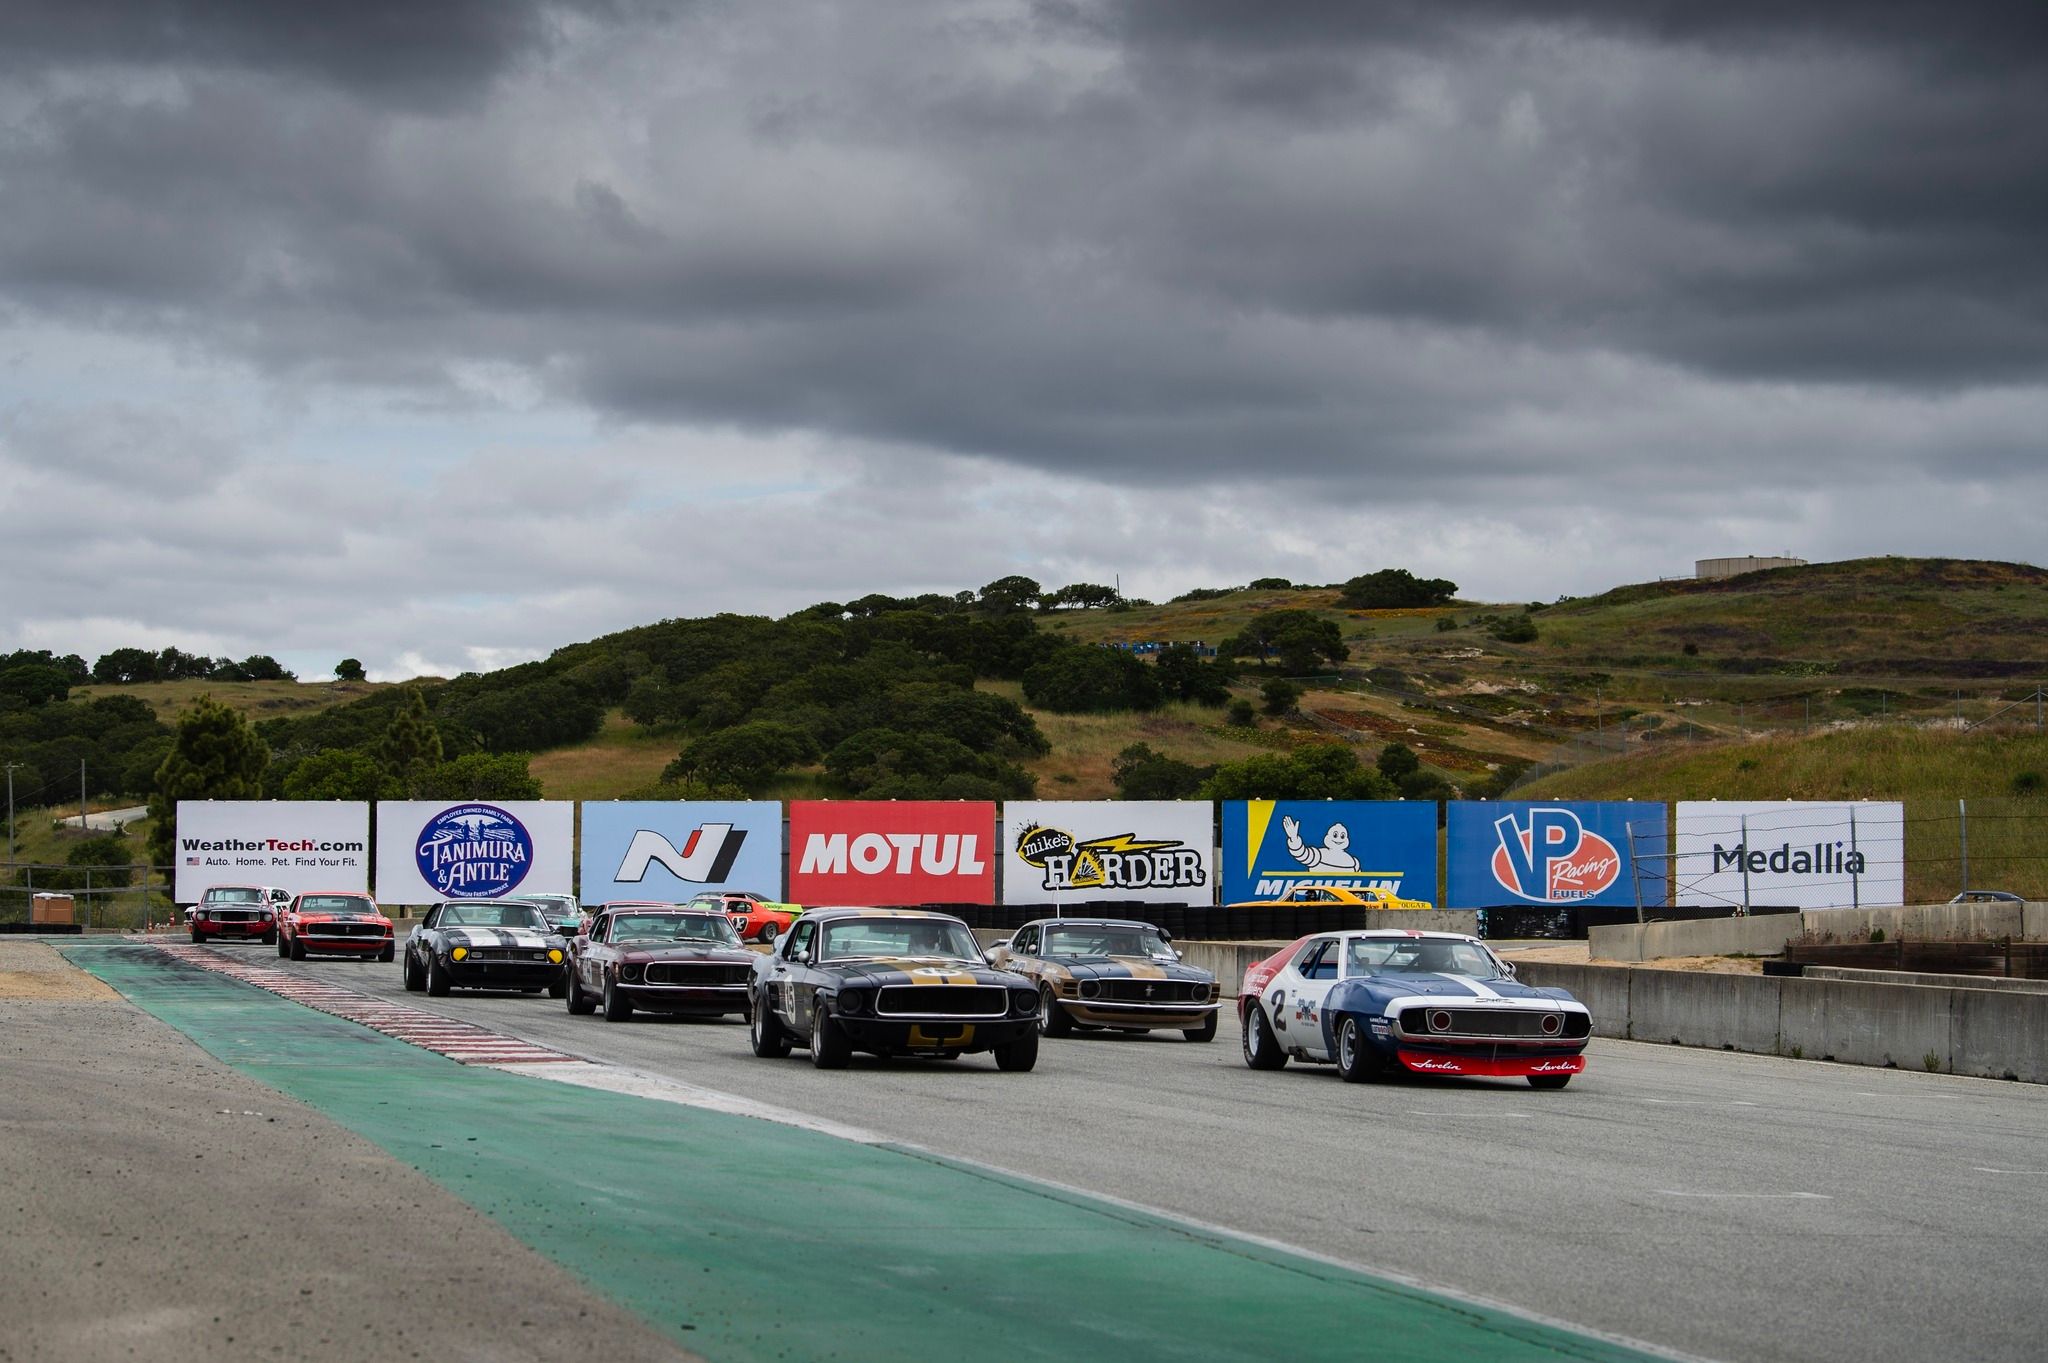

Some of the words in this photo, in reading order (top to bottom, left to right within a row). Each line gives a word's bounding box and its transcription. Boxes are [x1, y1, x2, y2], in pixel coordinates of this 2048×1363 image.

[436, 809, 462, 825] EMPLOYEE
[482, 808, 501, 818] FAMILY
[500, 812, 514, 826] FARM
[420, 834, 526, 872] TANIMURA
[799, 833, 985, 876] MOTUL
[1024, 833, 1070, 858] mike's
[1494, 808, 1583, 901] VP
[1713, 841, 1865, 874] Medallia
[205, 857, 230, 867] Auto.
[236, 857, 266, 867] Home.
[272, 857, 290, 867] Pet.
[295, 857, 316, 867] Find
[318, 857, 340, 867] Your
[343, 857, 358, 867] Fit.
[437, 869, 448, 884] &
[439, 861, 509, 893] ANTLE
[1044, 850, 1200, 889] HARDER
[1552, 856, 1617, 889] Racing
[1552, 888, 1596, 899] FUELS
[1271, 989, 1287, 1032] 2
[1411, 1059, 1462, 1071] Javelin
[1530, 1059, 1581, 1072] Javelin
